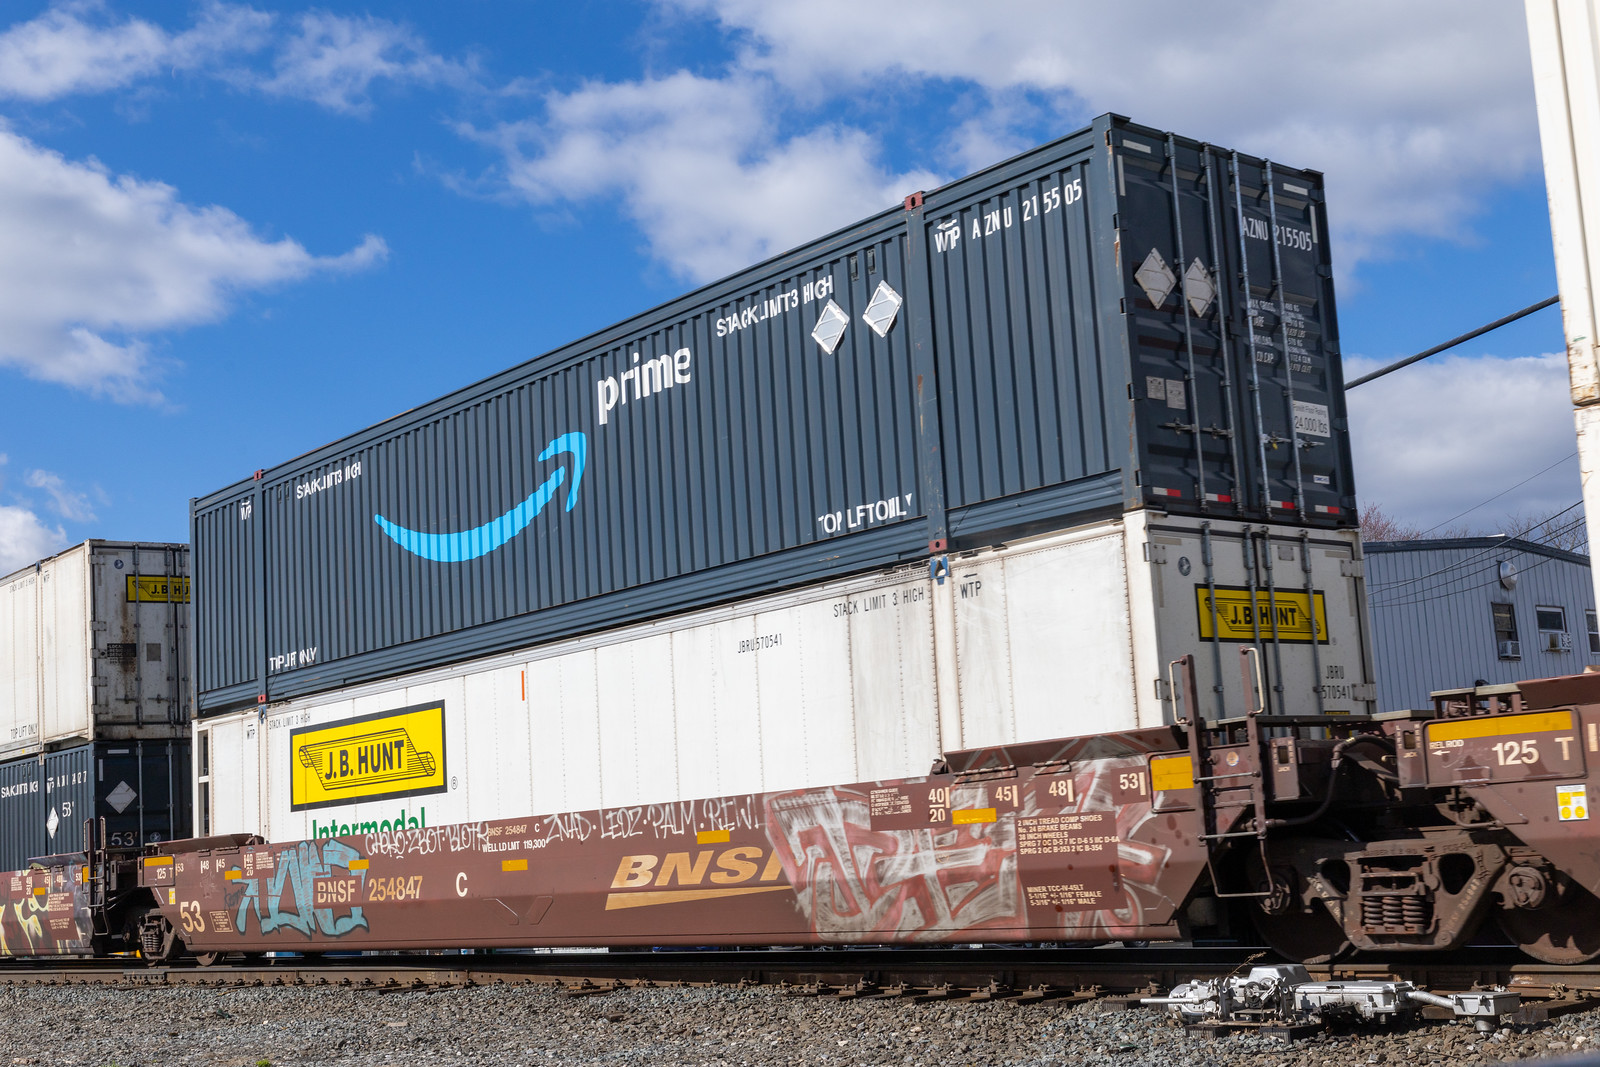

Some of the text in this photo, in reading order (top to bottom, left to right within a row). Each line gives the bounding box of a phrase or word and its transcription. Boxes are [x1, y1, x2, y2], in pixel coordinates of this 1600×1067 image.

[972, 206, 1012, 240] AZNU
[1022, 178, 1082, 222] 215505
[1242, 216, 1313, 251] AZNU 215505
[597, 347, 691, 426] prime
[847, 503, 875, 528] LFT
[960, 581, 982, 599] WTP
[834, 586, 924, 618] STACK LIMIT 3 HIGH
[738, 633, 782, 653] JBRU 570541
[1326, 665, 1344, 679] JBRU
[1321, 685, 1350, 700] 570541
[19, 725, 27, 738] LIFT
[28, 723, 38, 735] ONLY
[1446, 739, 1464, 748] ROD
[1492, 736, 1574, 766] 125 T
[358, 740, 405, 774] HUNT
[1048, 780, 1067, 797] 48
[1119, 772, 1139, 790] 53
[928, 788, 945, 803] 40
[995, 786, 1012, 802] 45
[929, 808, 946, 823] 20
[1039, 817, 1060, 825] TREAD
[1061, 816, 1079, 824] COMP
[312, 807, 426, 840] Intermodal
[488, 823, 540, 837] BNSF 254847 C
[1038, 824, 1059, 832] BRAKE
[1060, 823, 1082, 831] BEAMS
[111, 831, 138, 847] 53'
[1042, 831, 1068, 839] WHEELS
[482, 838, 546, 853] WELL LD LMT 119,300
[178, 863, 184, 872] 53
[203, 860, 210, 870] 48
[218, 859, 226, 868] 45
[156, 867, 174, 880] 125 T
[317, 872, 468, 904] BNSF 254847 C
[1076, 890, 1103, 898] FEMALE
[1078, 897, 1096, 905] MALE
[180, 900, 206, 933] 53
